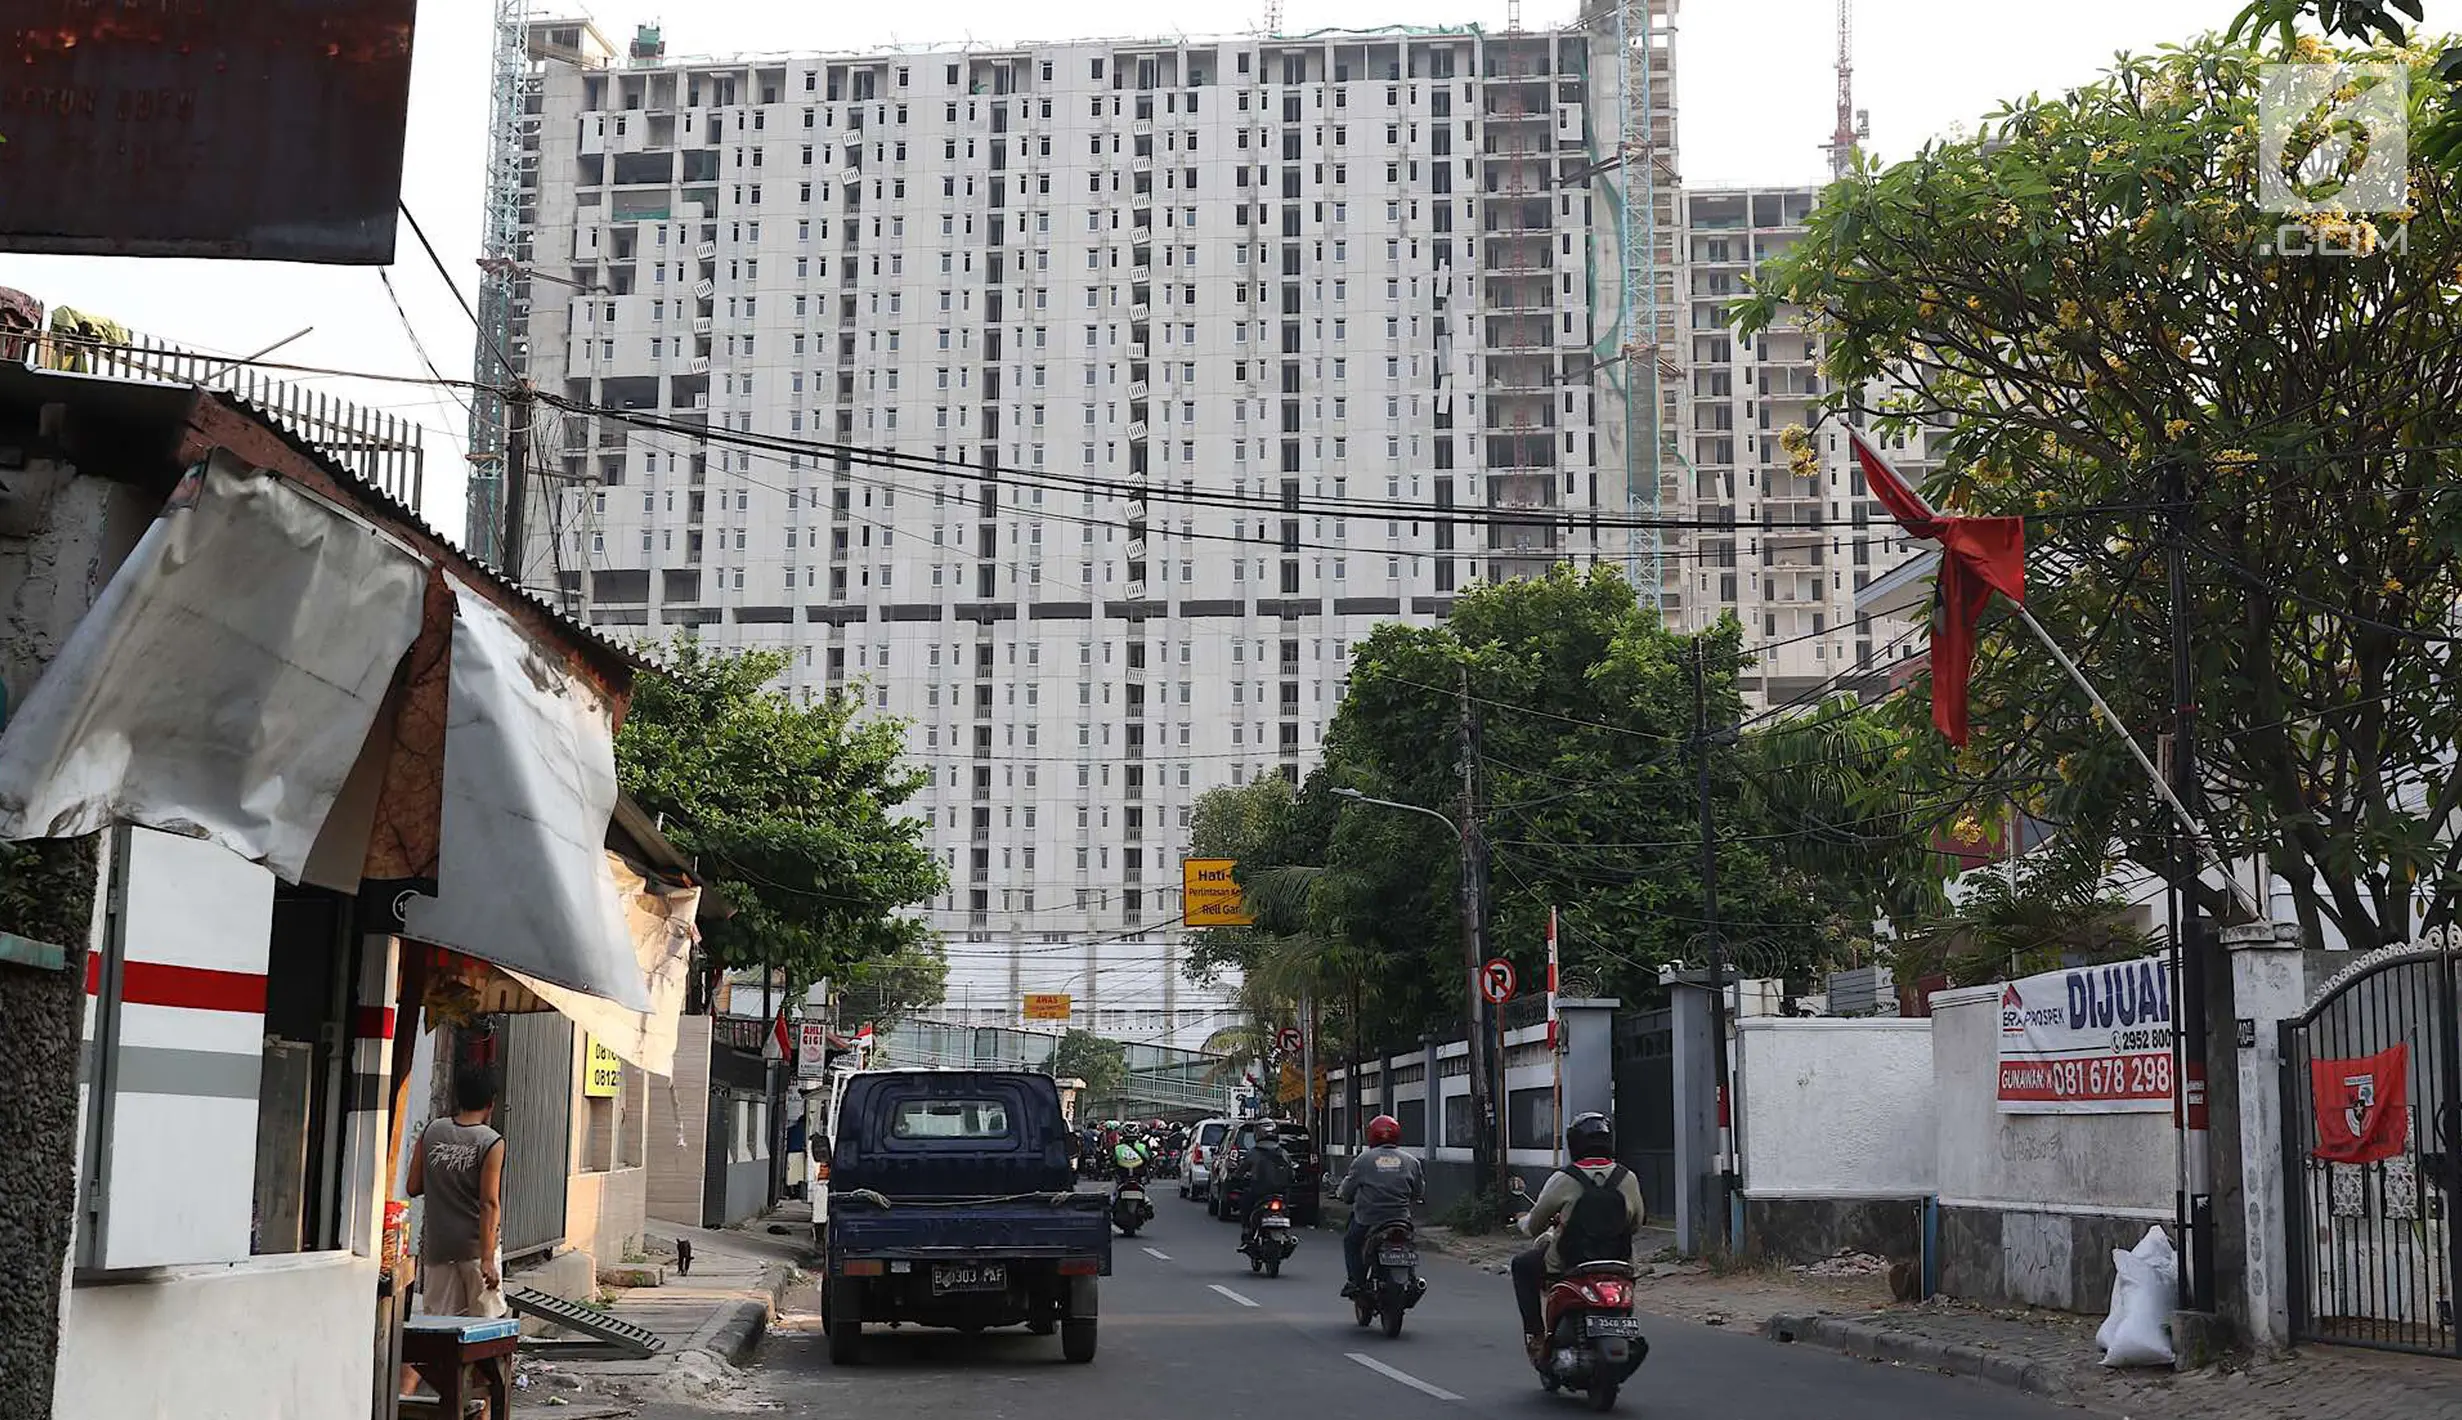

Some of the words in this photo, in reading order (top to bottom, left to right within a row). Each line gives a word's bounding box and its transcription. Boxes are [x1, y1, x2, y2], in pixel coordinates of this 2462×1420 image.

[2024, 1007, 2065, 1027] PROSPEK
[803, 1025, 824, 1035] AHLI
[803, 1035, 823, 1046] GIGI
[2122, 1033, 2150, 1050] 2952
[2090, 1059, 2124, 1094] 678
